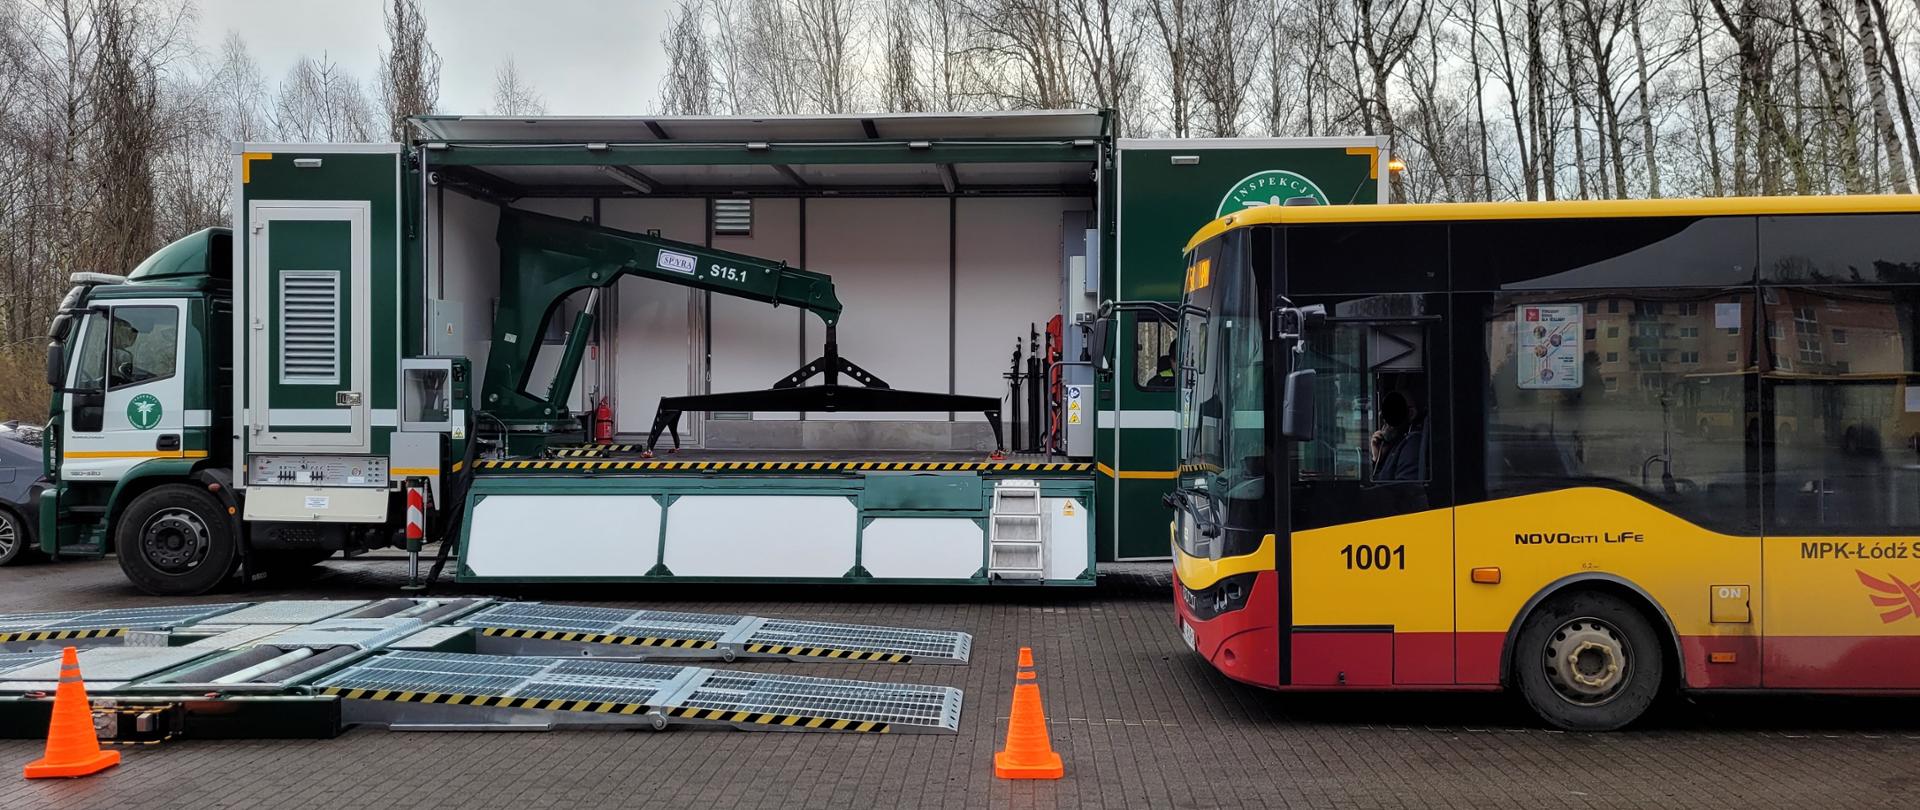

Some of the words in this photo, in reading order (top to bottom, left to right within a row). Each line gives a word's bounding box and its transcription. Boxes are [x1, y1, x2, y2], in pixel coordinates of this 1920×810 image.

[710, 264, 747, 282] S15.1
[1340, 544, 1405, 570] 1001
[1801, 542, 1908, 559] MPK-Łódź
[1719, 588, 1741, 599] ON
